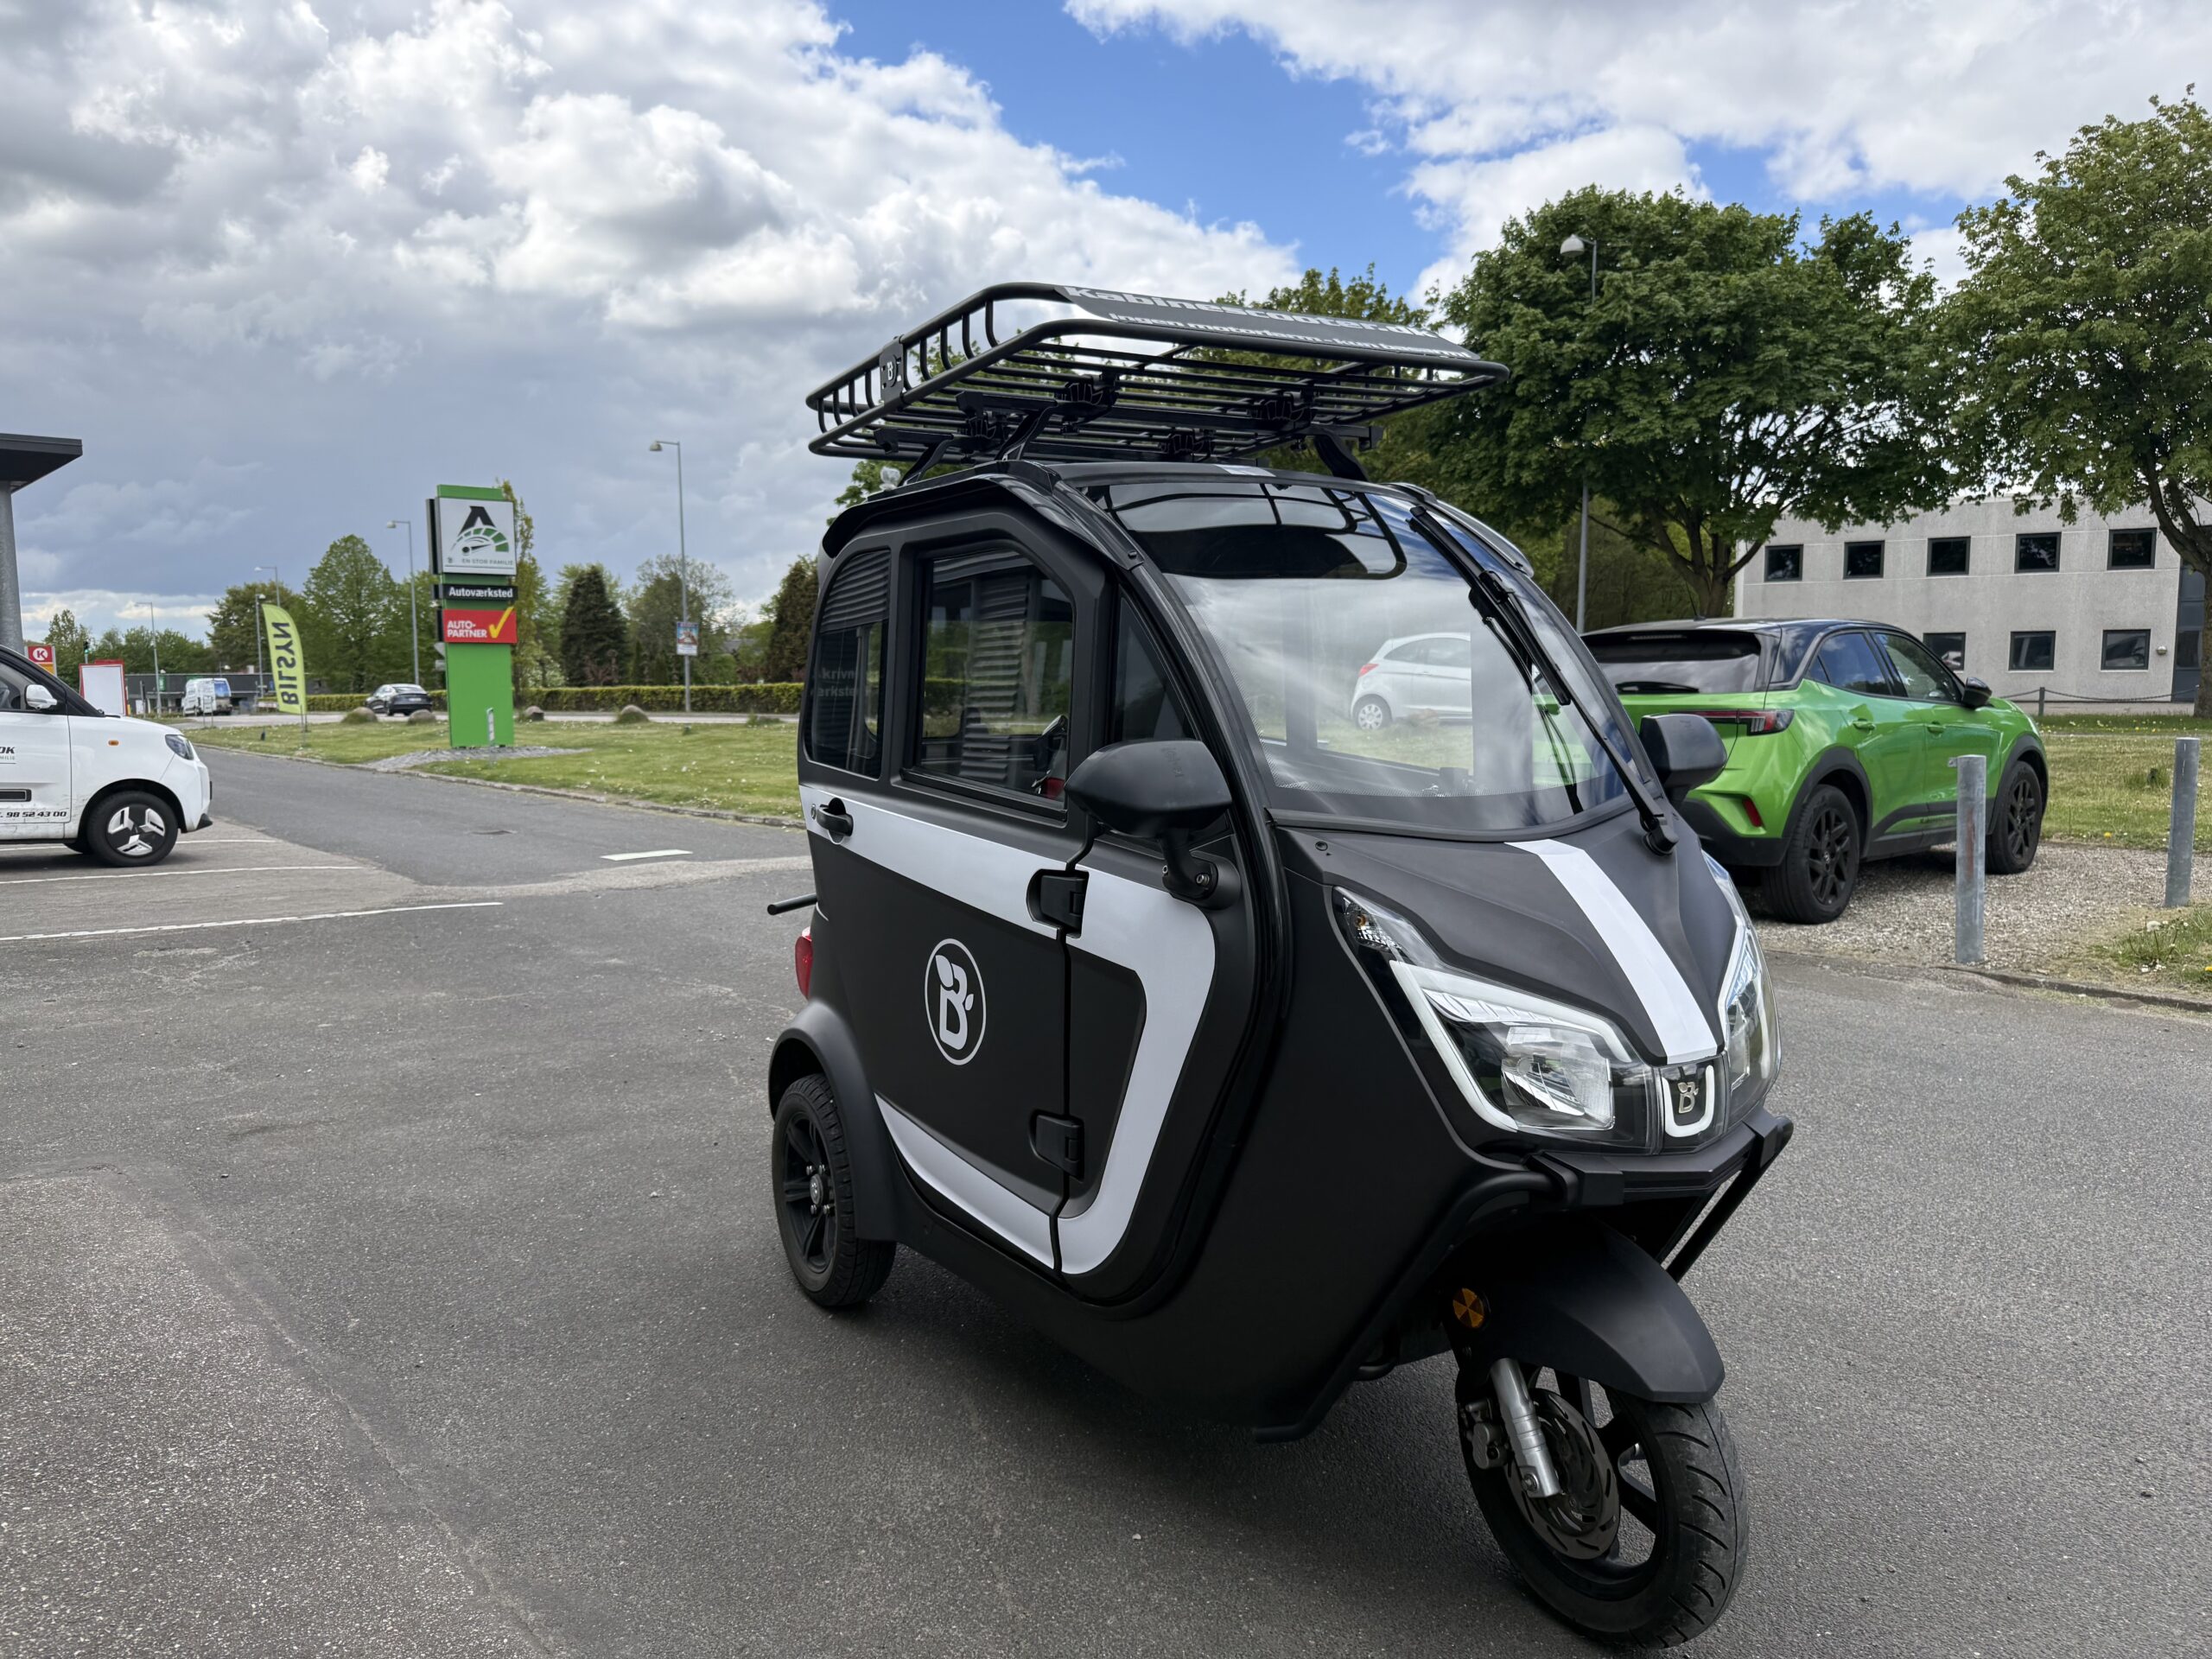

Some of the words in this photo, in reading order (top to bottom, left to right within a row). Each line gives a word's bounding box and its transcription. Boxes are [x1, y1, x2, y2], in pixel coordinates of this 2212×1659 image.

[1063, 285, 1439, 339] Kabinescooter.dk
[448, 587, 514, 598] Autoværksted
[447, 620, 476, 629] AUTO-
[447, 629, 487, 639] PARTNER
